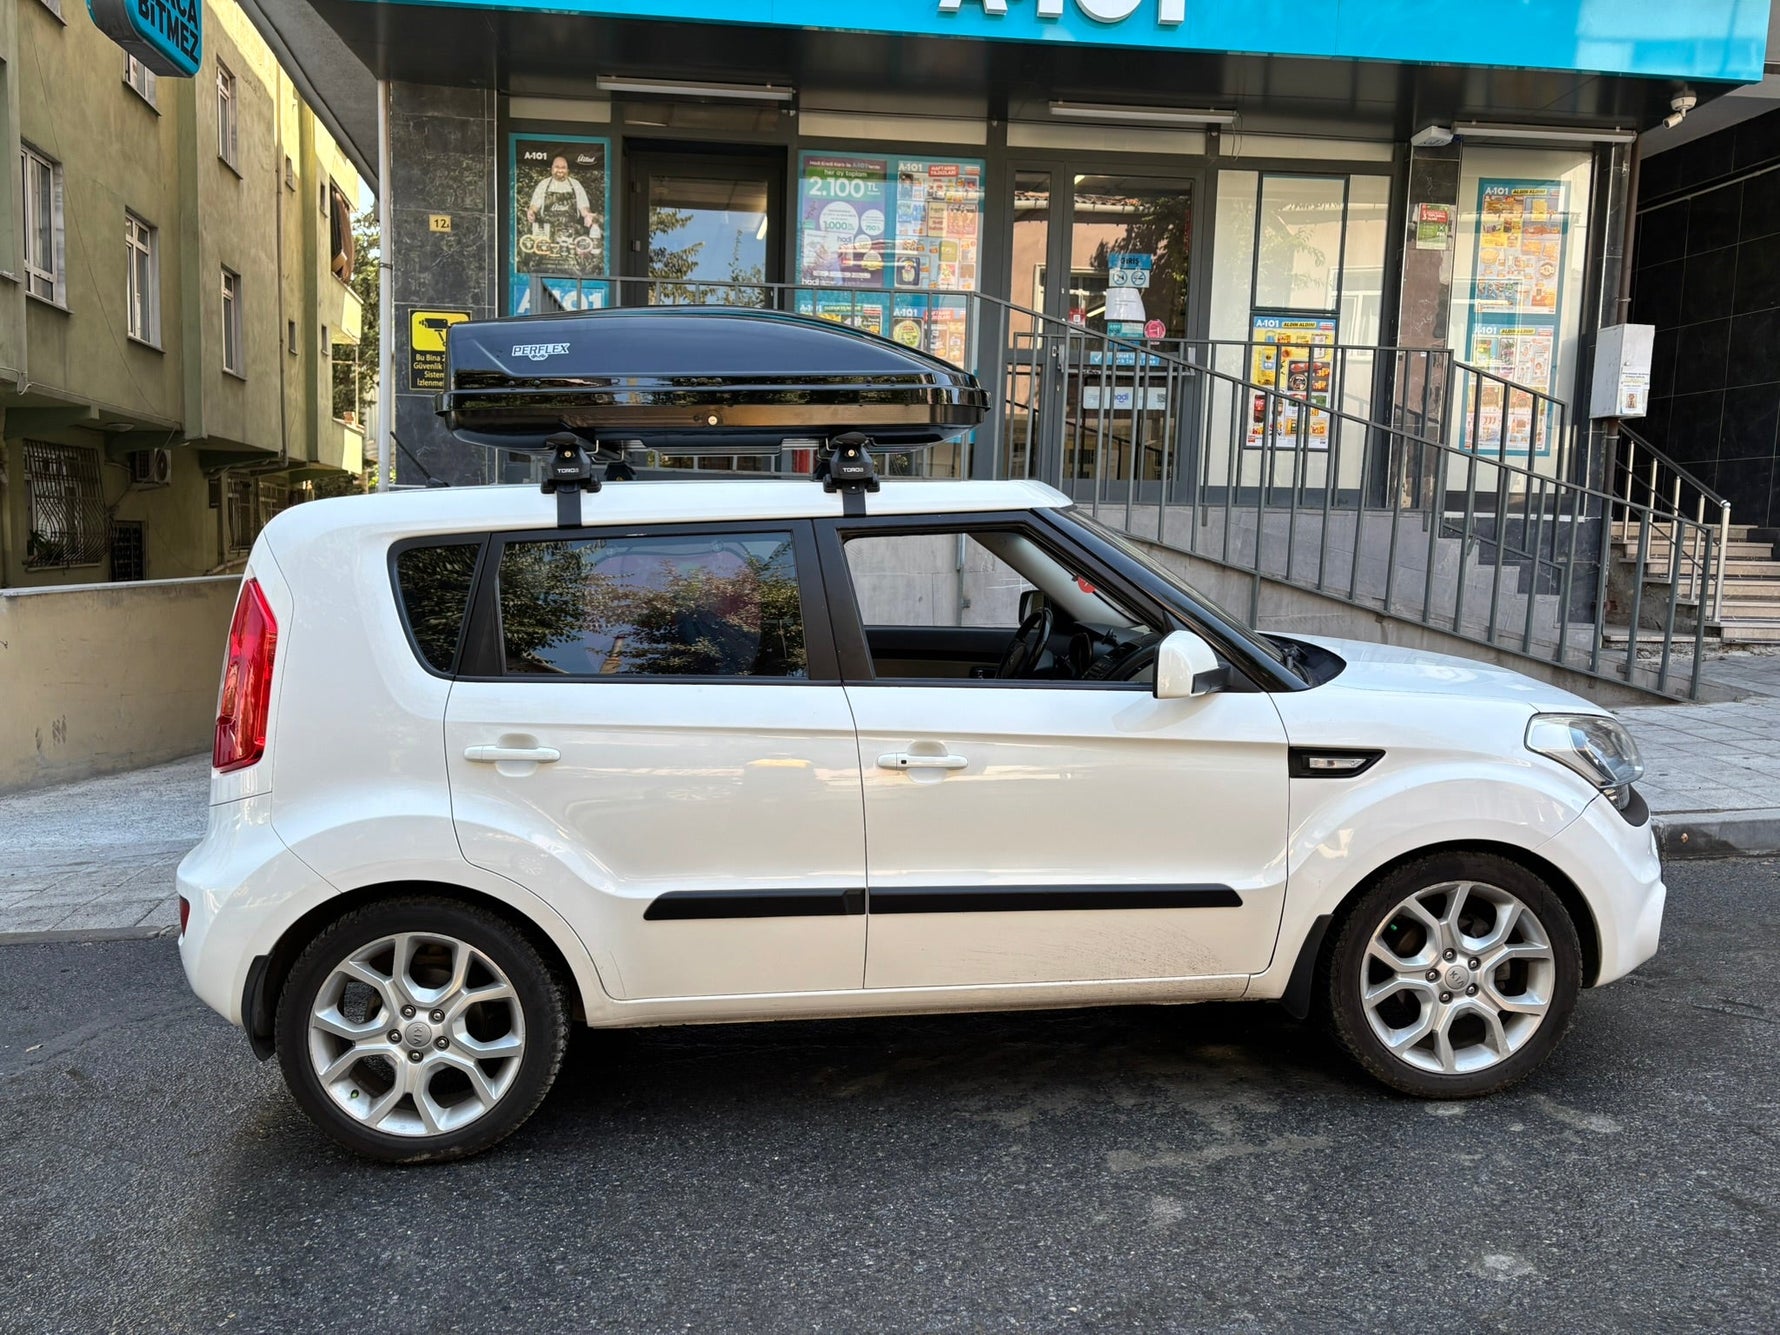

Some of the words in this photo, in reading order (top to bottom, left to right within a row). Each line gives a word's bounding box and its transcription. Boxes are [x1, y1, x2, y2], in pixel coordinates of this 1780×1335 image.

[809, 176, 865, 198] 2.100
[866, 182, 879, 191] TL
[512, 343, 570, 356] PERFLEX
[415, 353, 425, 361] Bu
[426, 354, 441, 362] Bina
[413, 361, 443, 370] Güvenlik
